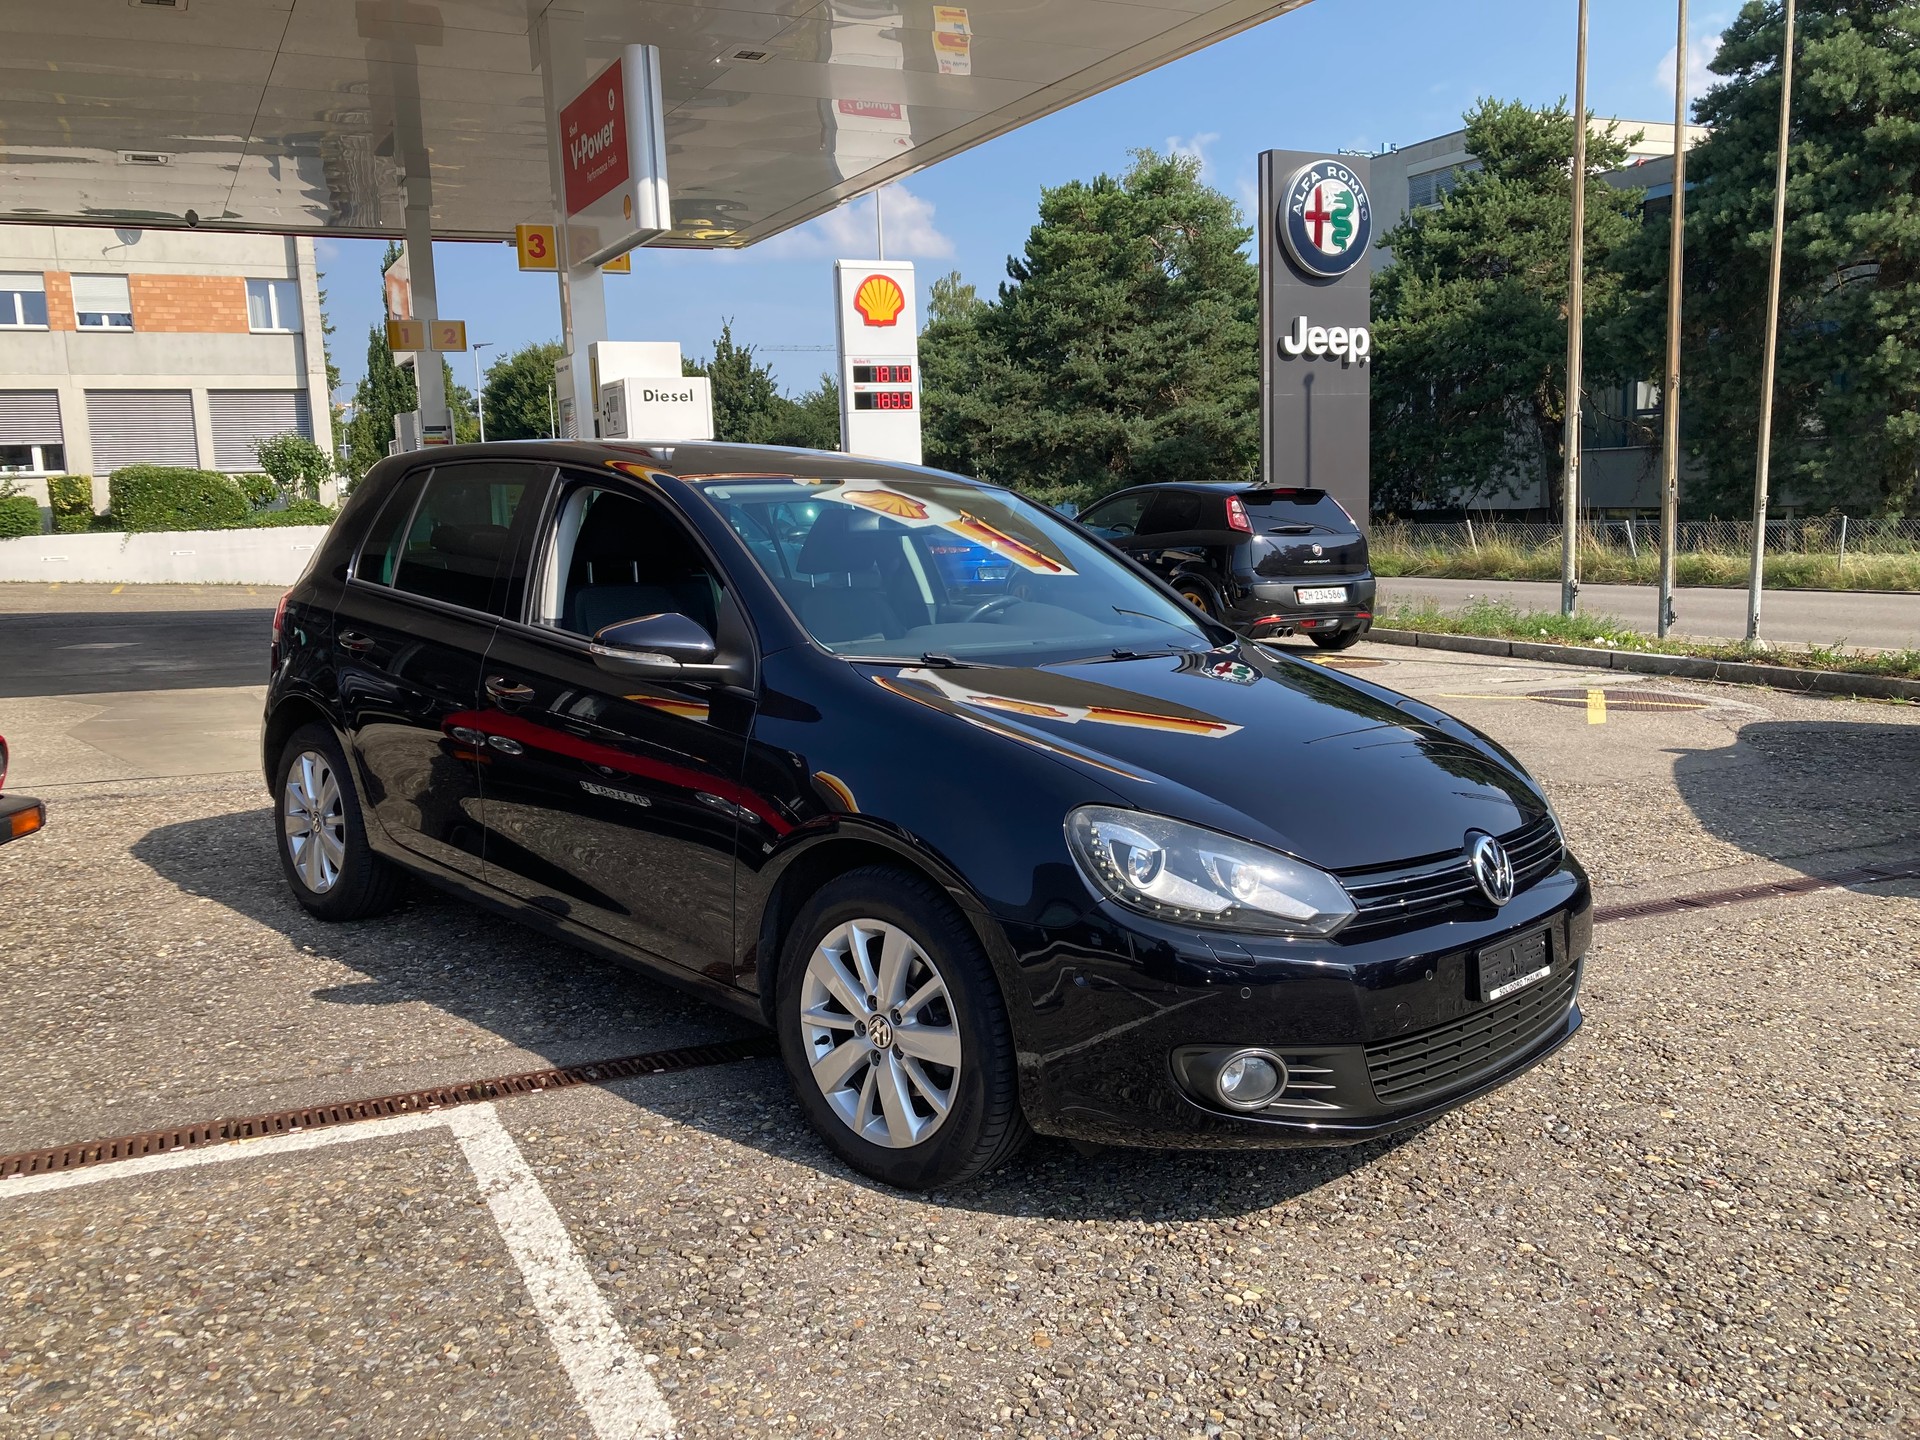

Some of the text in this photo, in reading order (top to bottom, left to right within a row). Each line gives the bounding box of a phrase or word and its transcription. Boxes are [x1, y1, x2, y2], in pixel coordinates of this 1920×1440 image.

[570, 118, 615, 171] V-Power
[1292, 166, 1368, 221] ALFA ROMEO
[527, 233, 547, 259] 3
[401, 328, 410, 344] 1
[443, 328, 457, 344] 2
[1284, 315, 1370, 363] Jeep
[643, 388, 694, 402] Diesel
